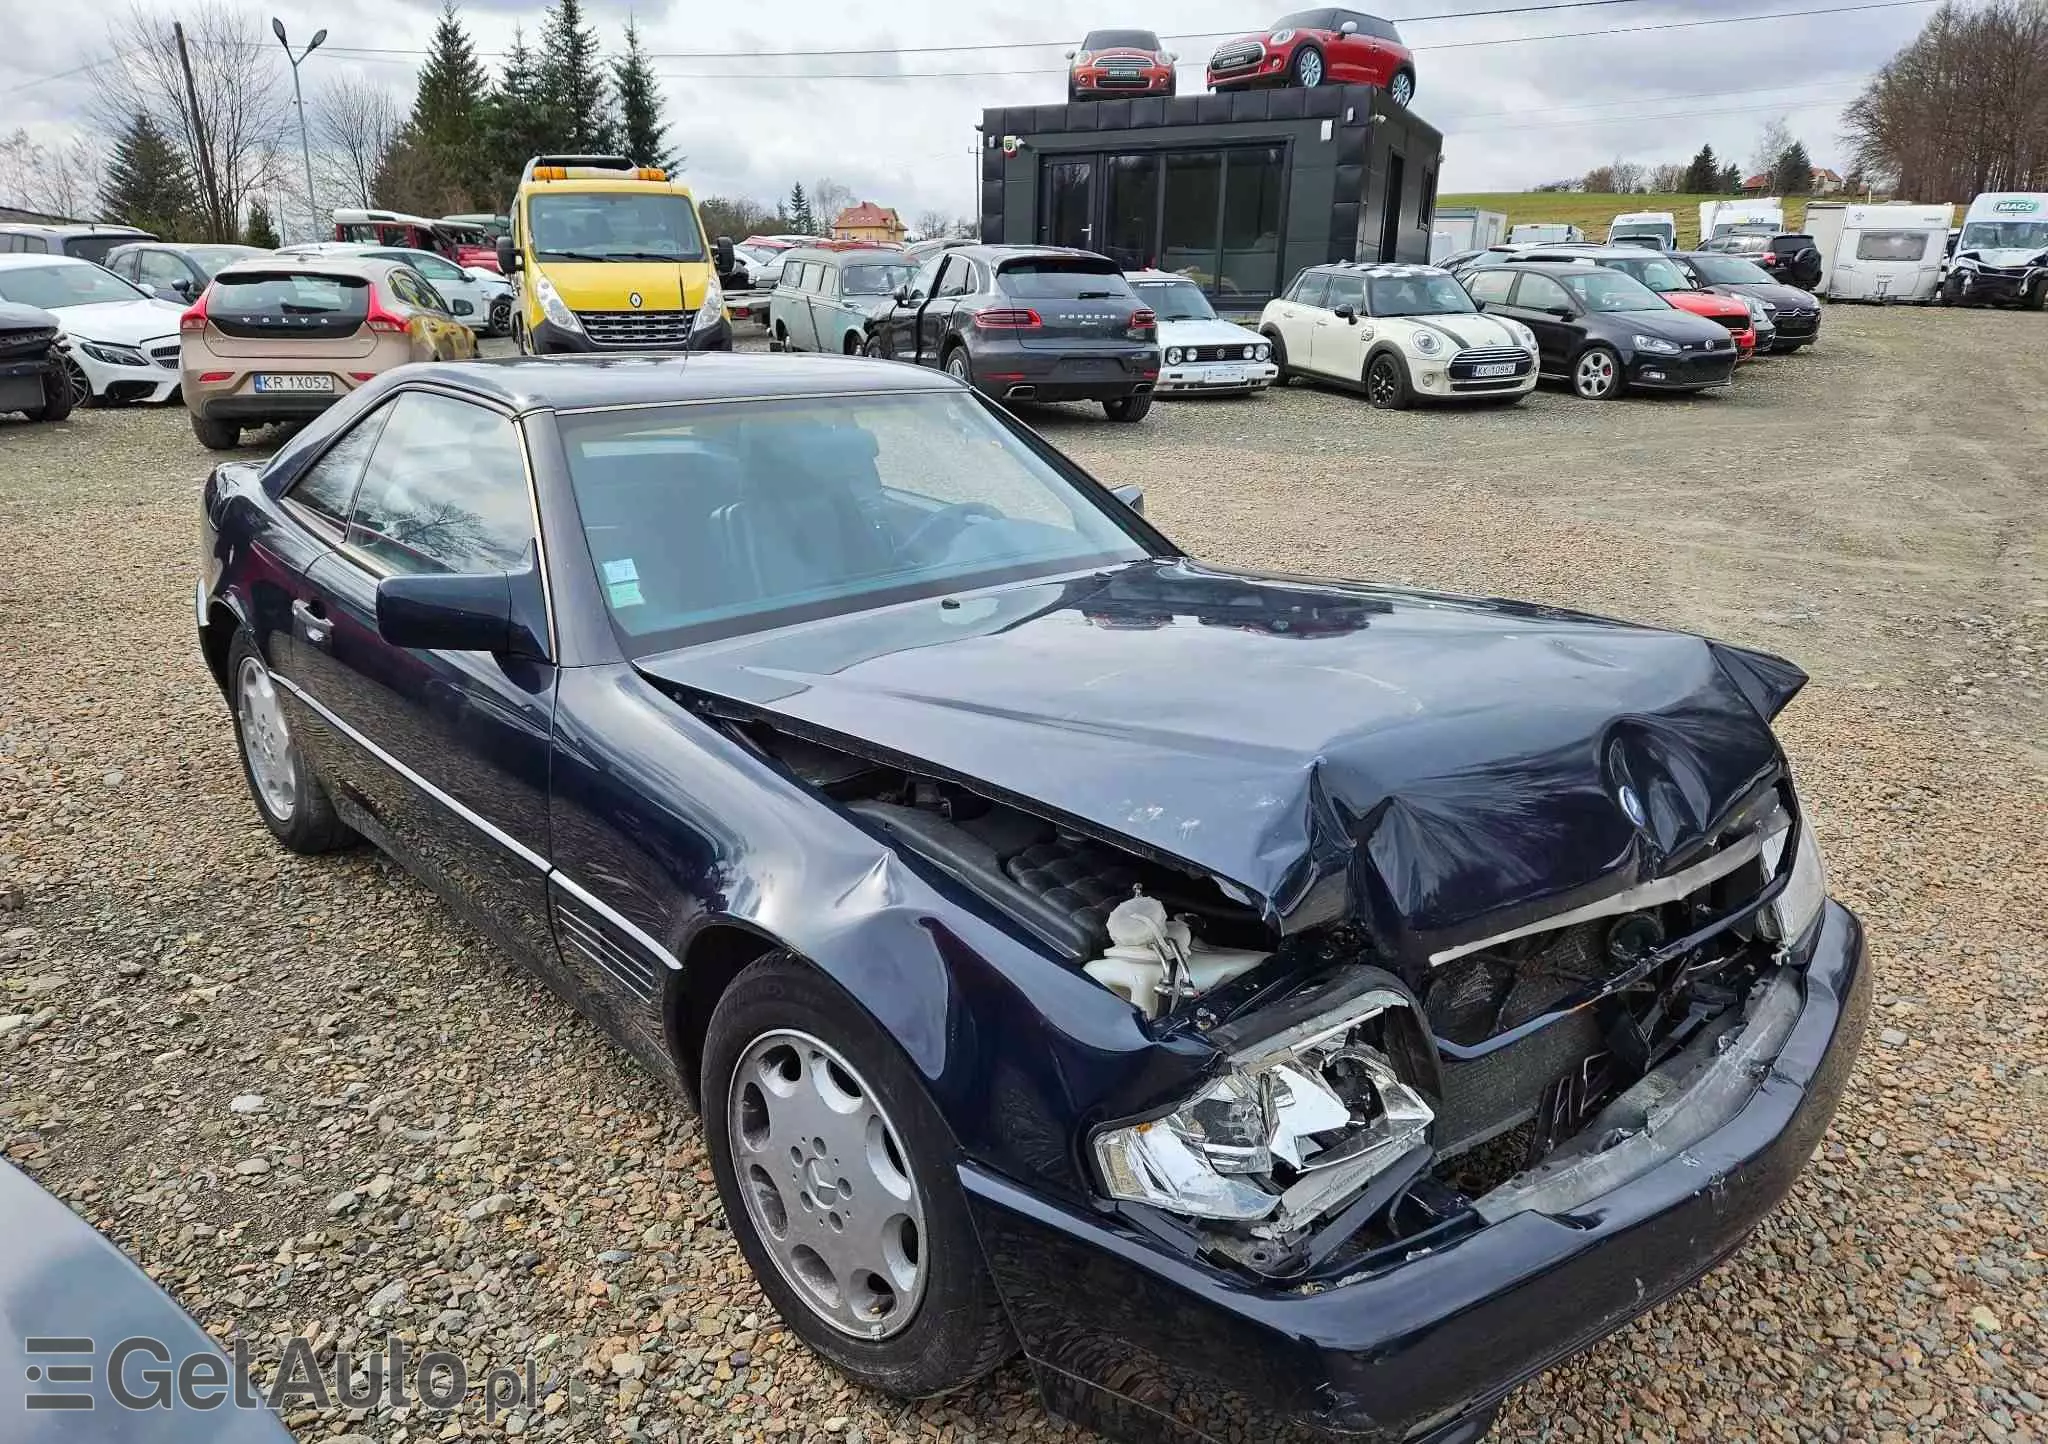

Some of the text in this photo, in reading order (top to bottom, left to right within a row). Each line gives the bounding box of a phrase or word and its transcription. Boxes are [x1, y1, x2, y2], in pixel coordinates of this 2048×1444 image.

[242, 316, 328, 324] VOLVO
[263, 376, 329, 389] KR 1X052
